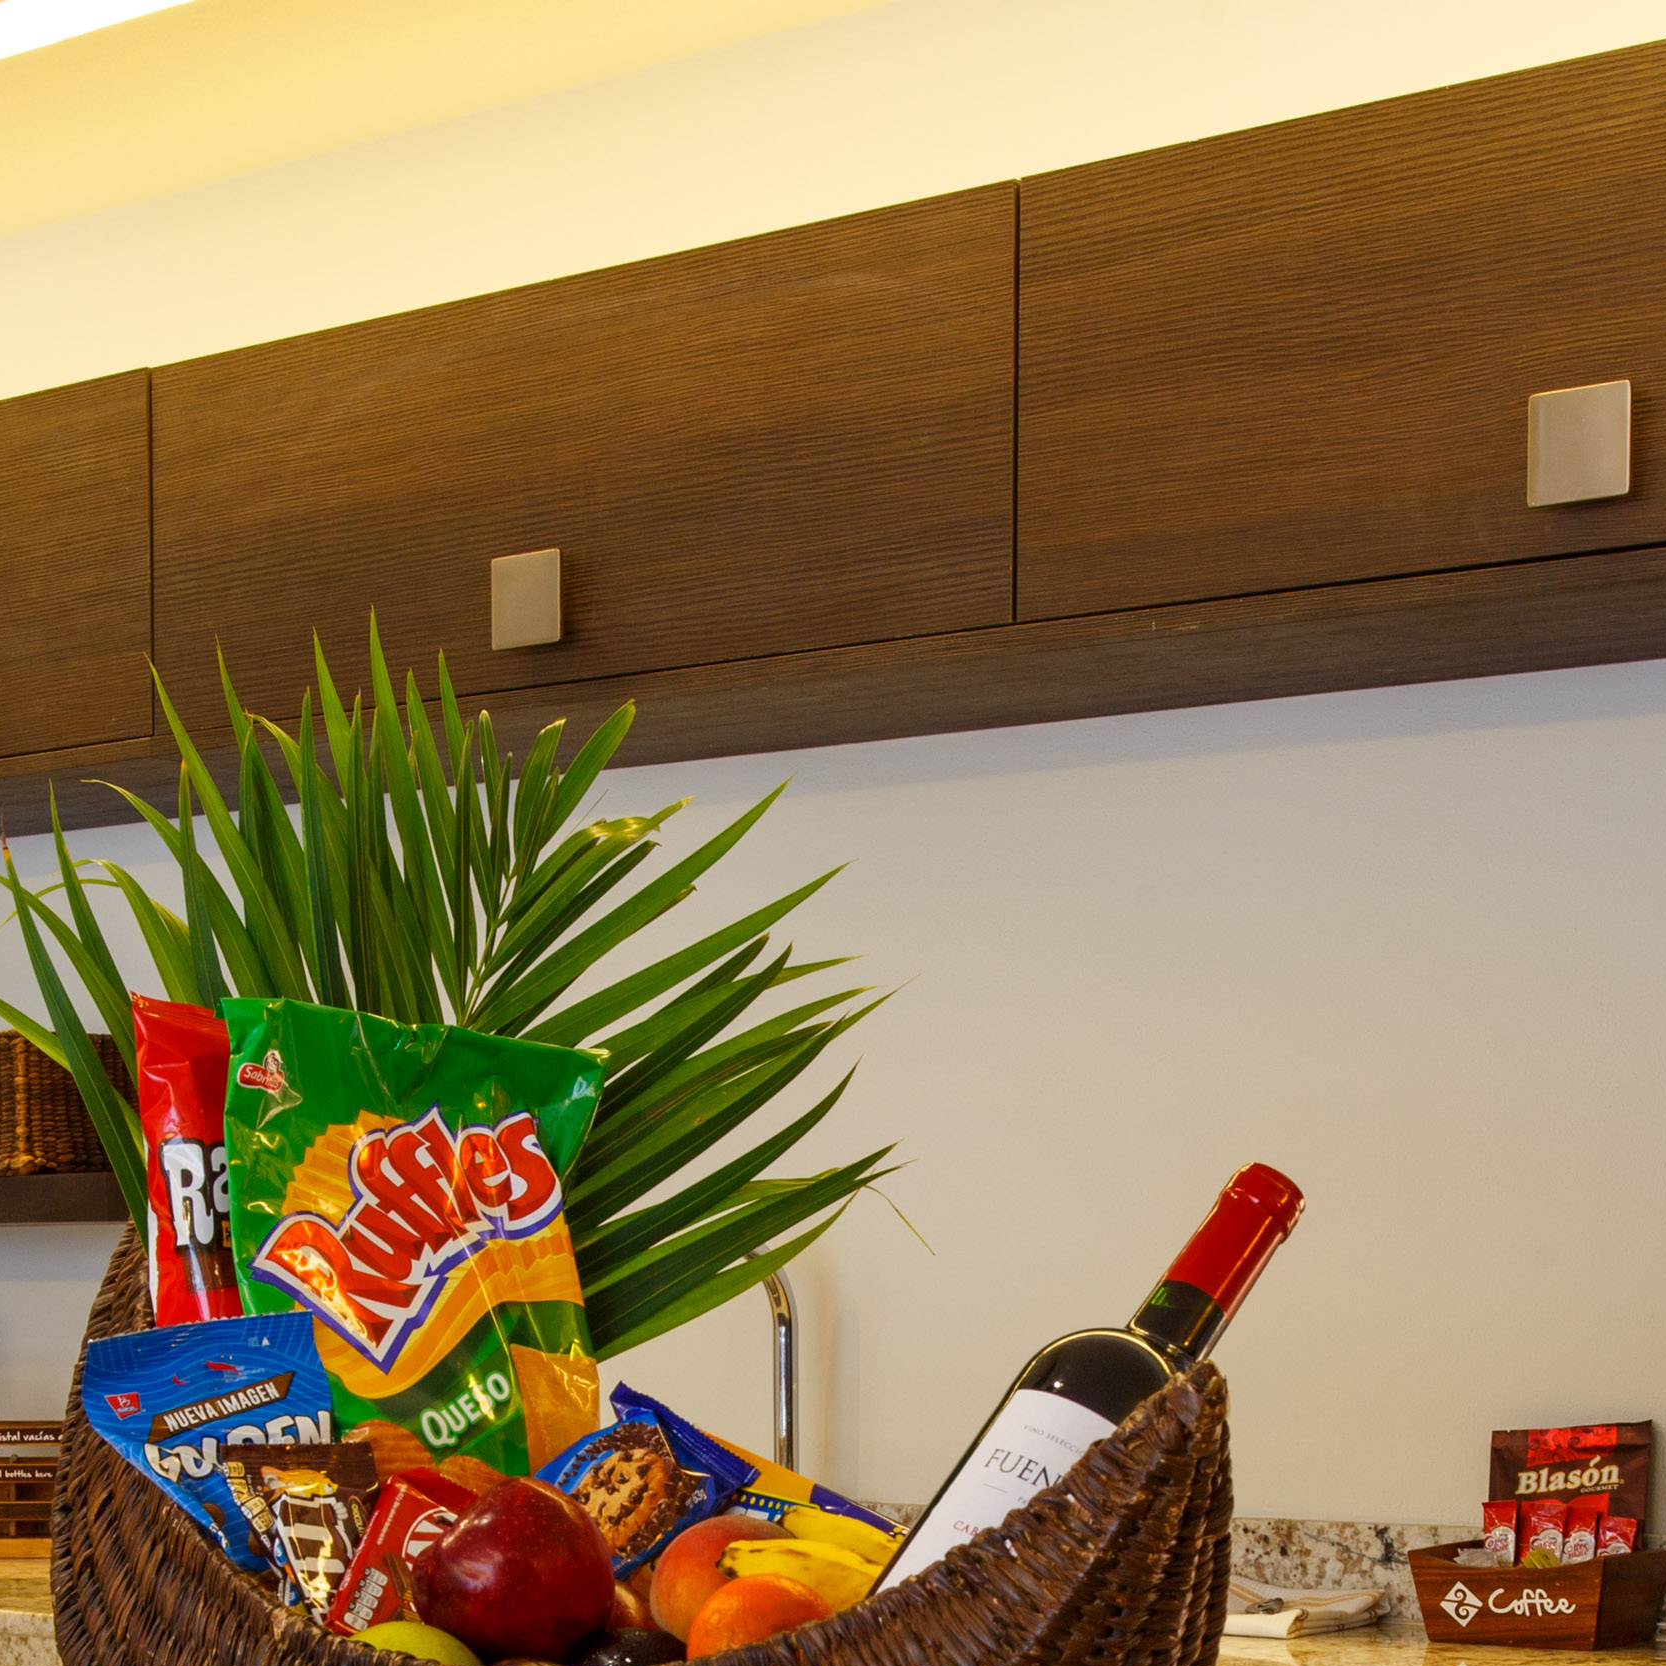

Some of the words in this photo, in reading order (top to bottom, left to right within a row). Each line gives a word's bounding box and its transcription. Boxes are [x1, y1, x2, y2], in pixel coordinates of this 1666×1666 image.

[263, 1116, 559, 1350] Ruffles
[163, 1403, 219, 1432] NUEVA
[216, 1381, 280, 1414] IMAGEN
[422, 1373, 511, 1447] QUESO
[23, 1431, 55, 1442] vacías
[1023, 1424, 1044, 1436] VINO
[5, 1470, 32, 1478] bottles
[35, 1470, 53, 1478] here
[1515, 1455, 1620, 1495] Blasón
[1580, 1484, 1619, 1494] GOURMET
[1488, 1588, 1576, 1617] Coffee
